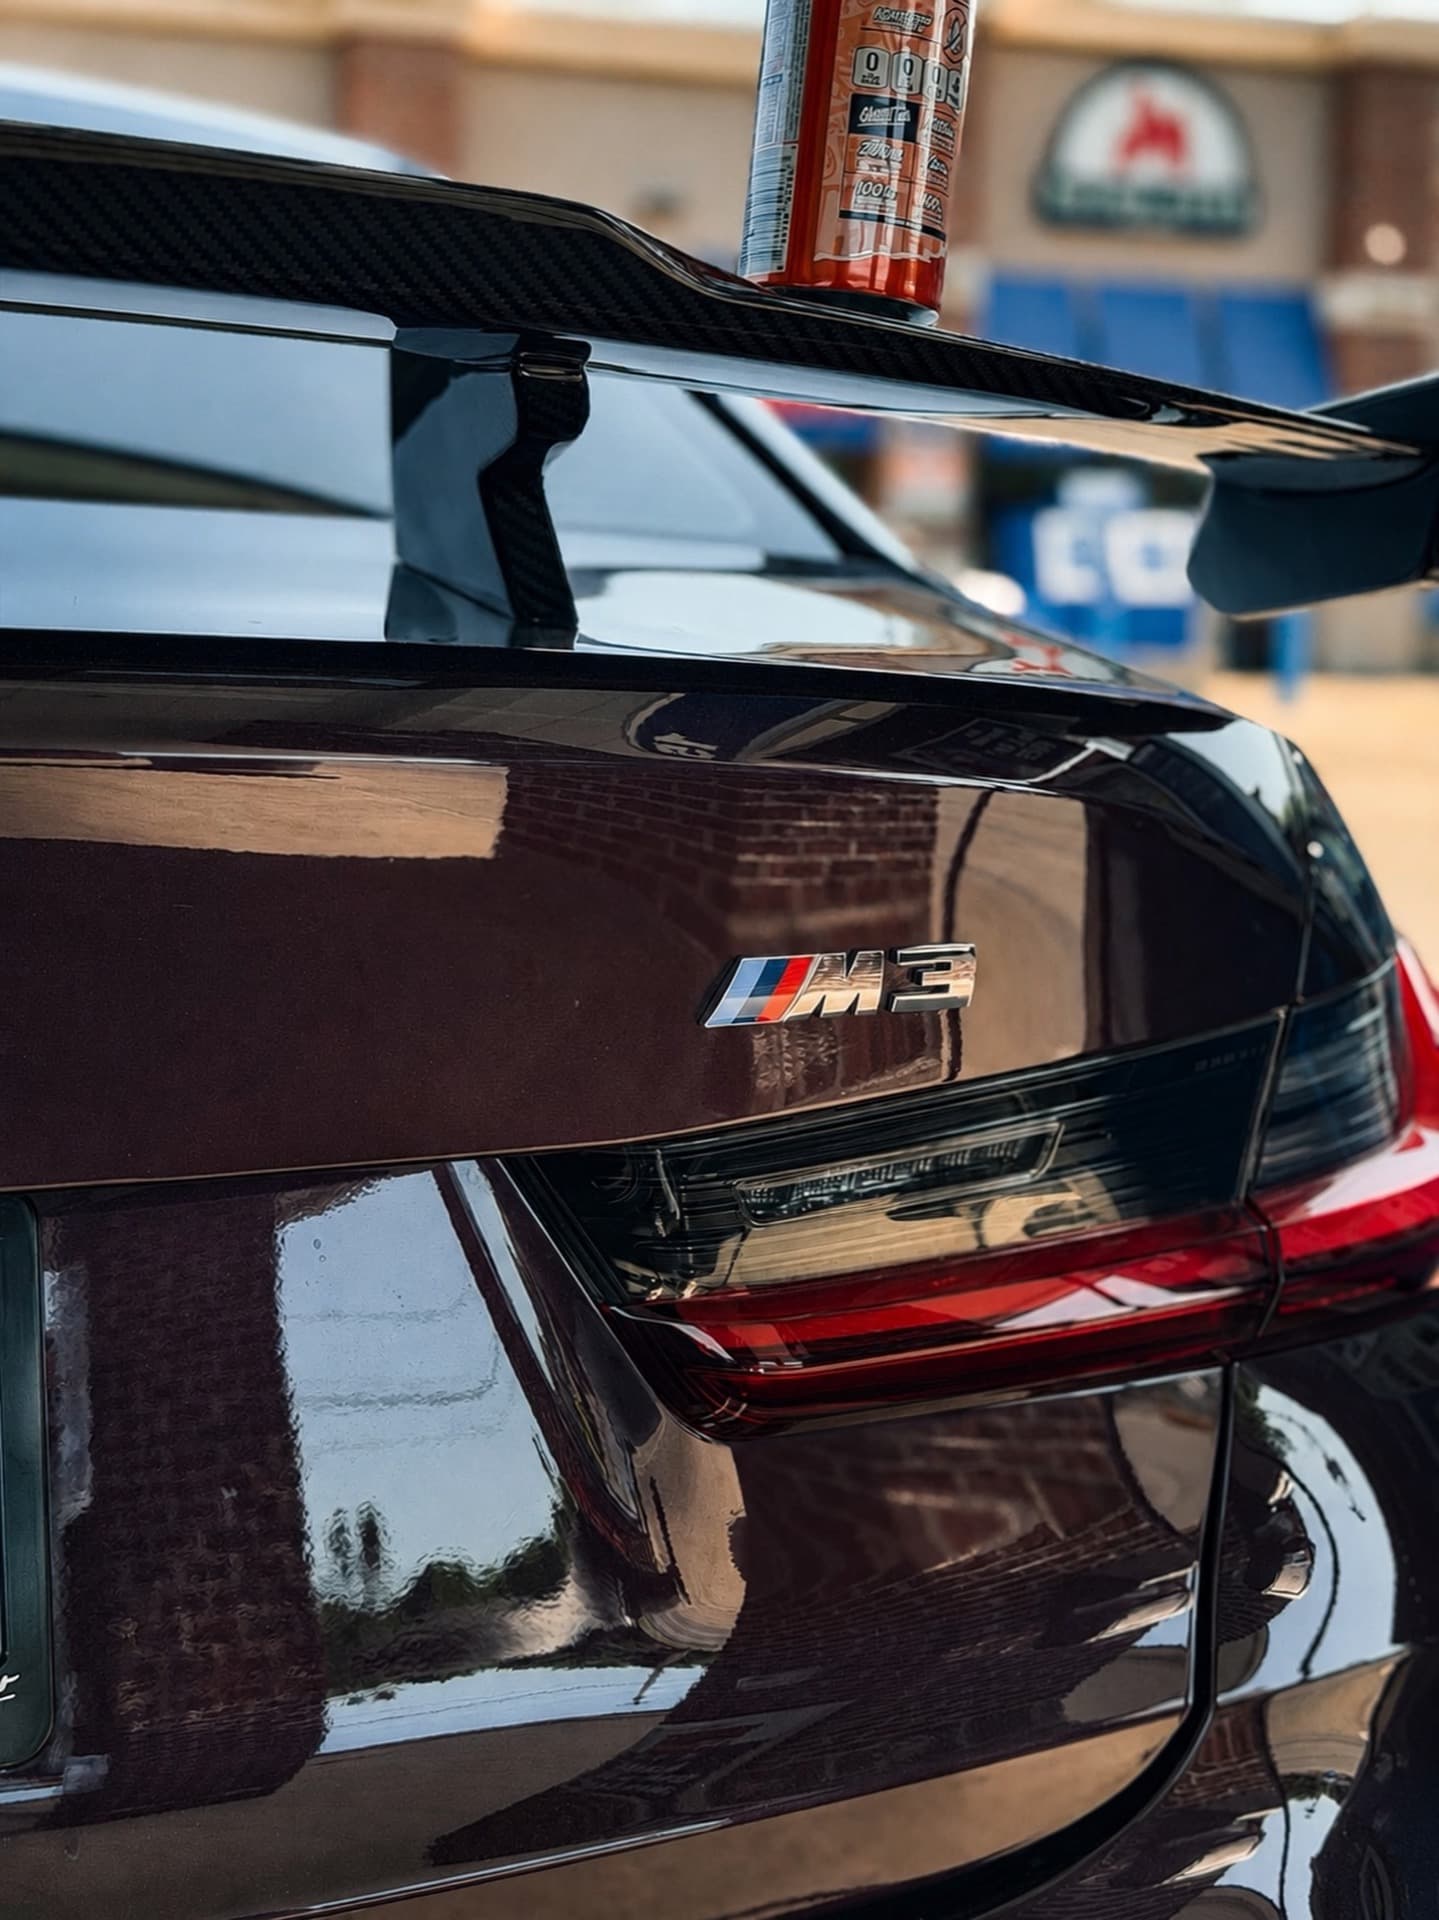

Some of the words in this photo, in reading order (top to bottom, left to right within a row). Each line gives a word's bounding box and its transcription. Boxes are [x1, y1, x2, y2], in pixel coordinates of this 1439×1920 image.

[866, 52, 879, 71] 0
[903, 58, 914, 76] 0
[783, 943, 977, 1023] M3
